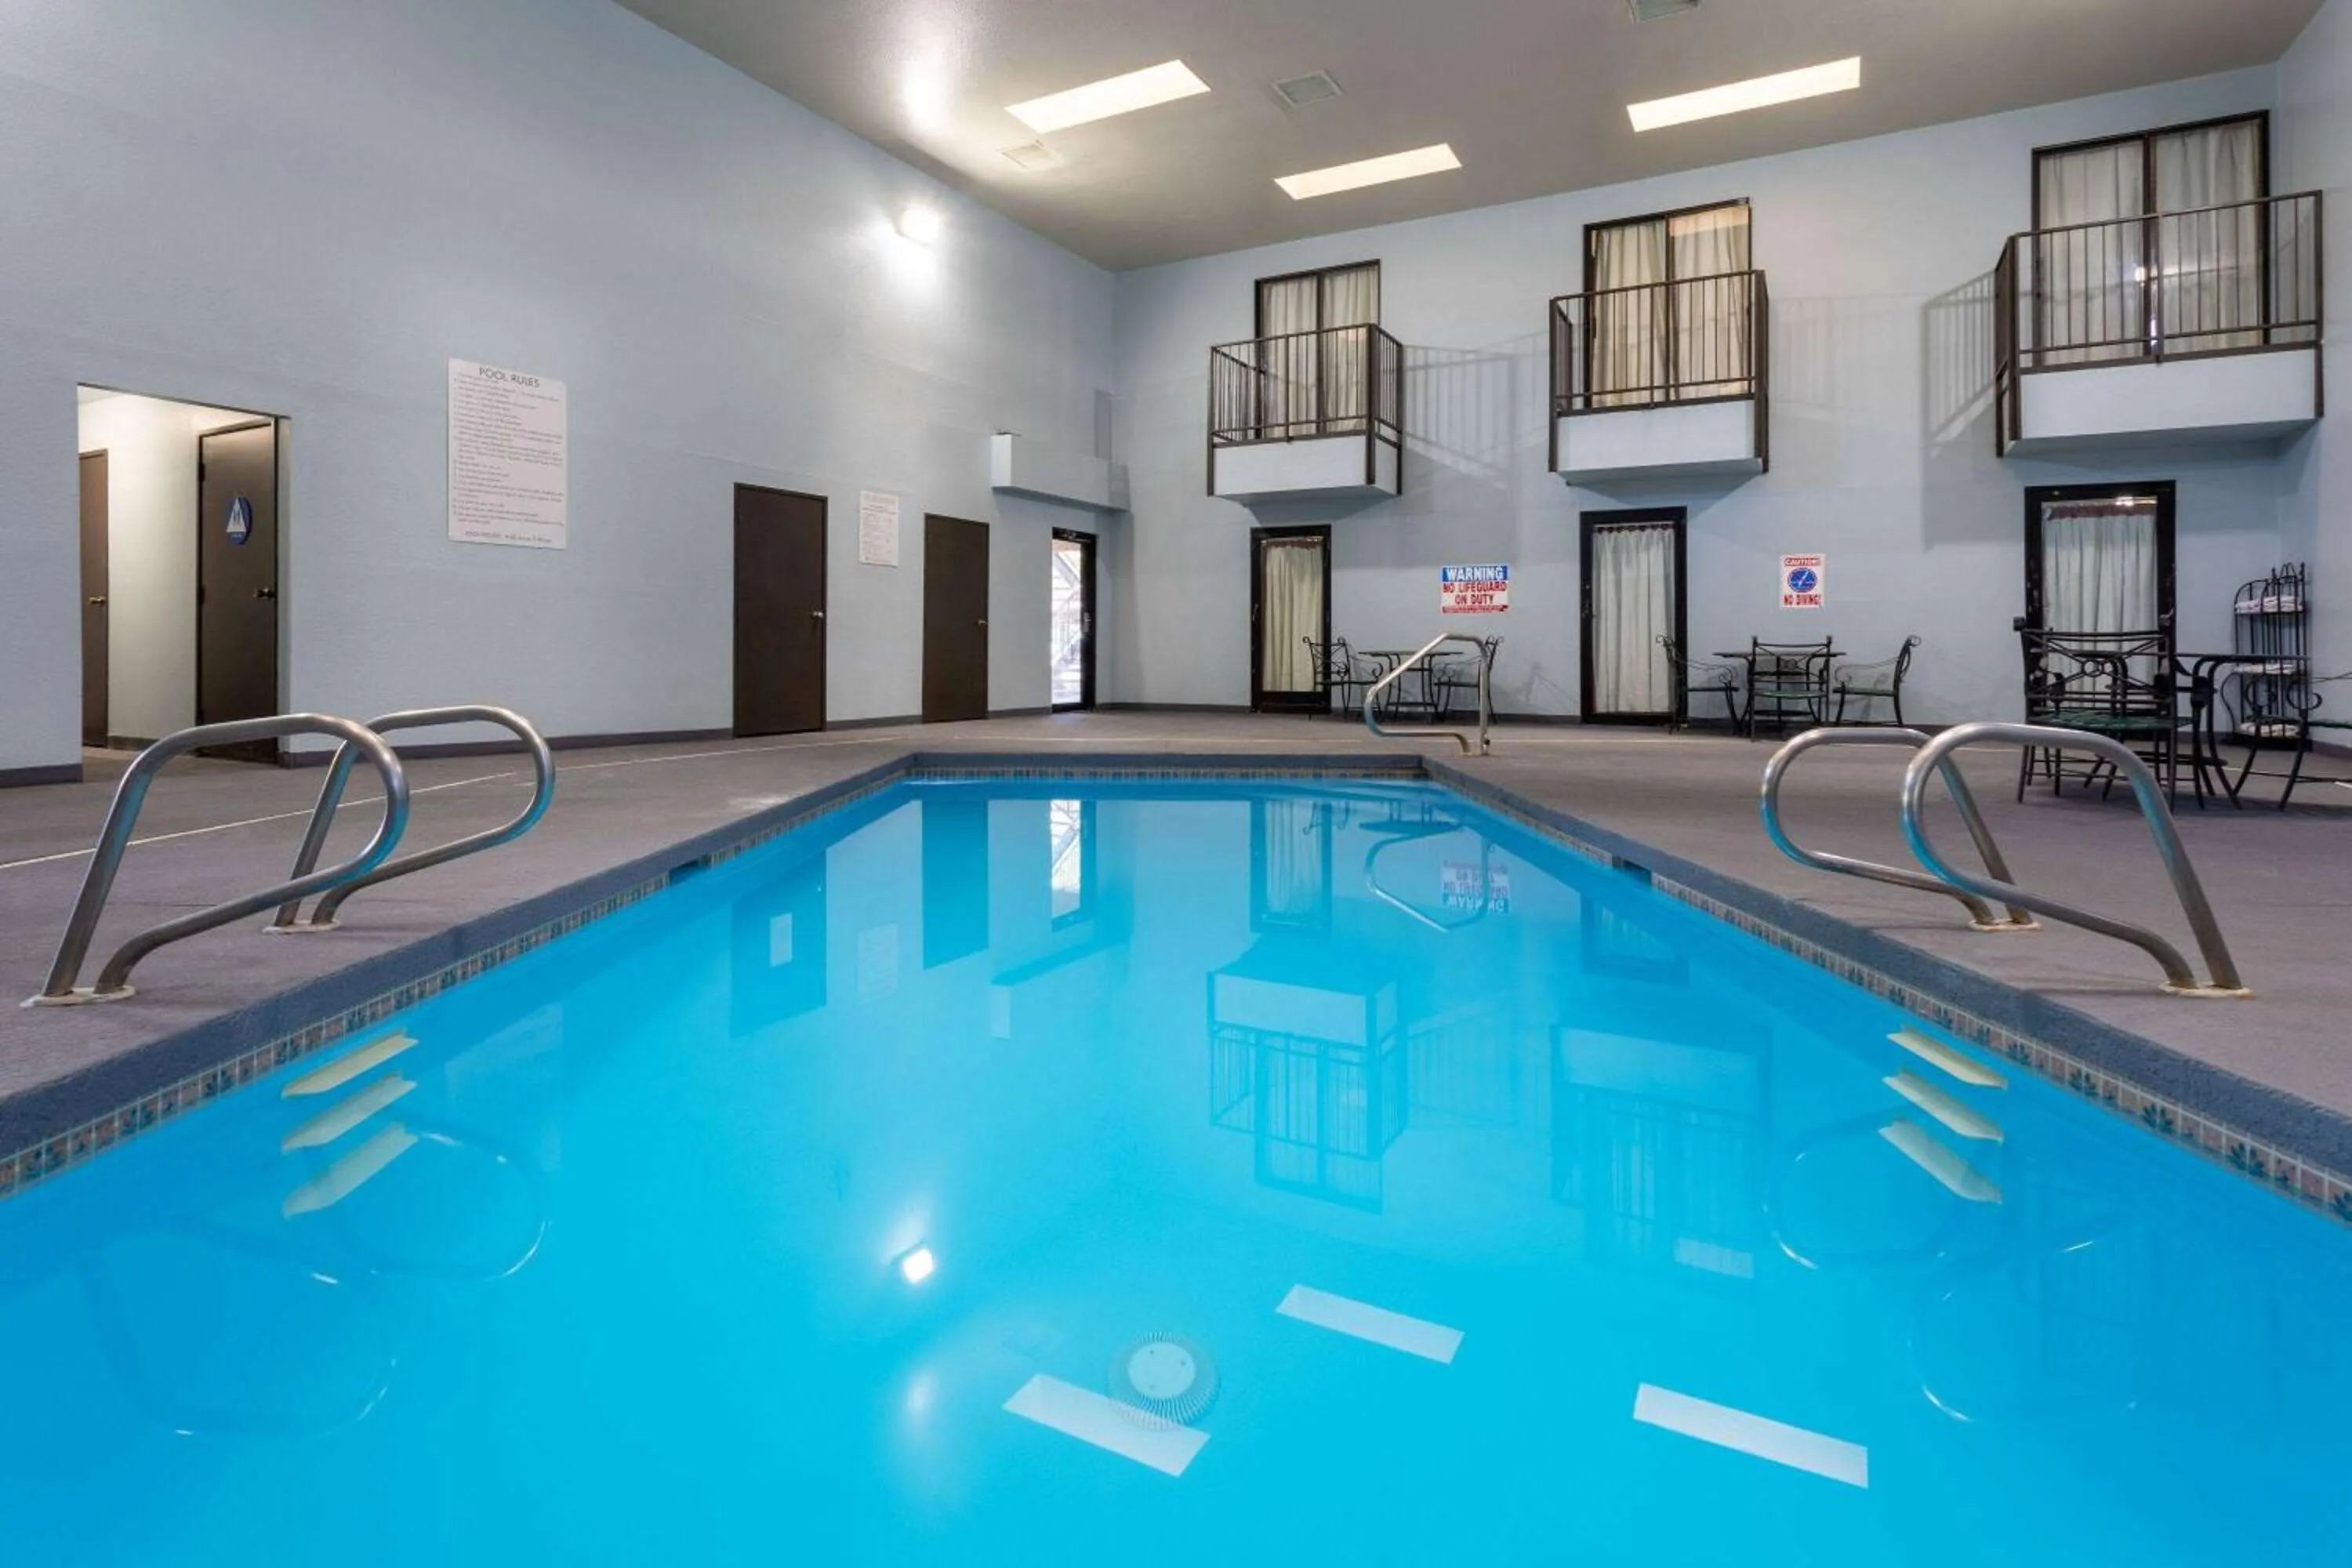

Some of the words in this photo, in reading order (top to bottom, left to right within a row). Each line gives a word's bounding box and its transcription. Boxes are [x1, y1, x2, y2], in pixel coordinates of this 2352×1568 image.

[479, 366, 507, 382] POOL
[510, 374, 540, 389] RULES
[1446, 567, 1504, 581] WARNING
[1443, 582, 1455, 593] NO
[1458, 581, 1506, 593] LIFEGUARD
[1455, 594, 1467, 604] ON
[1471, 593, 1493, 604] DUTY
[1784, 594, 1793, 605] NO
